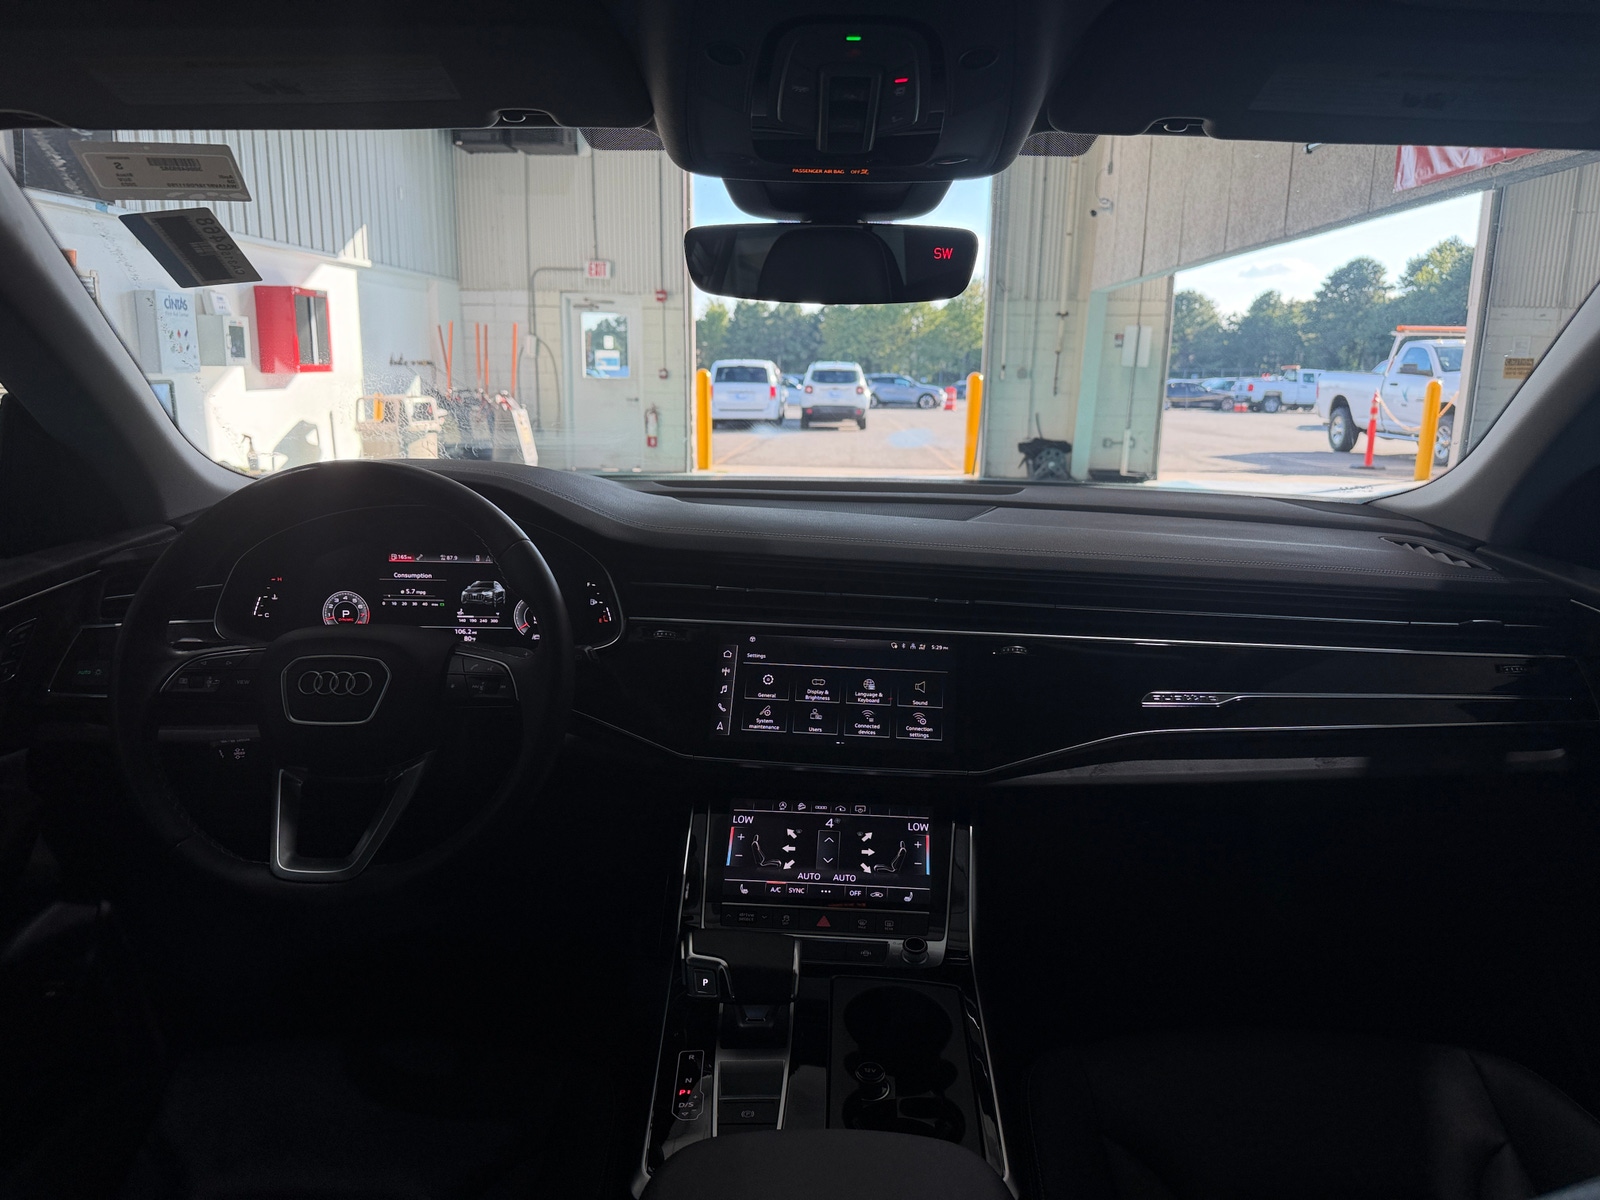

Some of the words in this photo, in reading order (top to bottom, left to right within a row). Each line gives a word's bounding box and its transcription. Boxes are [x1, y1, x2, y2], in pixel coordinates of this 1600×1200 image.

[934, 247, 953, 260] SW
[588, 262, 606, 277] EXIT
[732, 815, 754, 824] LOW
[825, 818, 834, 828] 4
[906, 822, 930, 832] LOW
[797, 872, 821, 881] AUTO
[833, 874, 857, 882] AUTO
[702, 978, 709, 987] P
